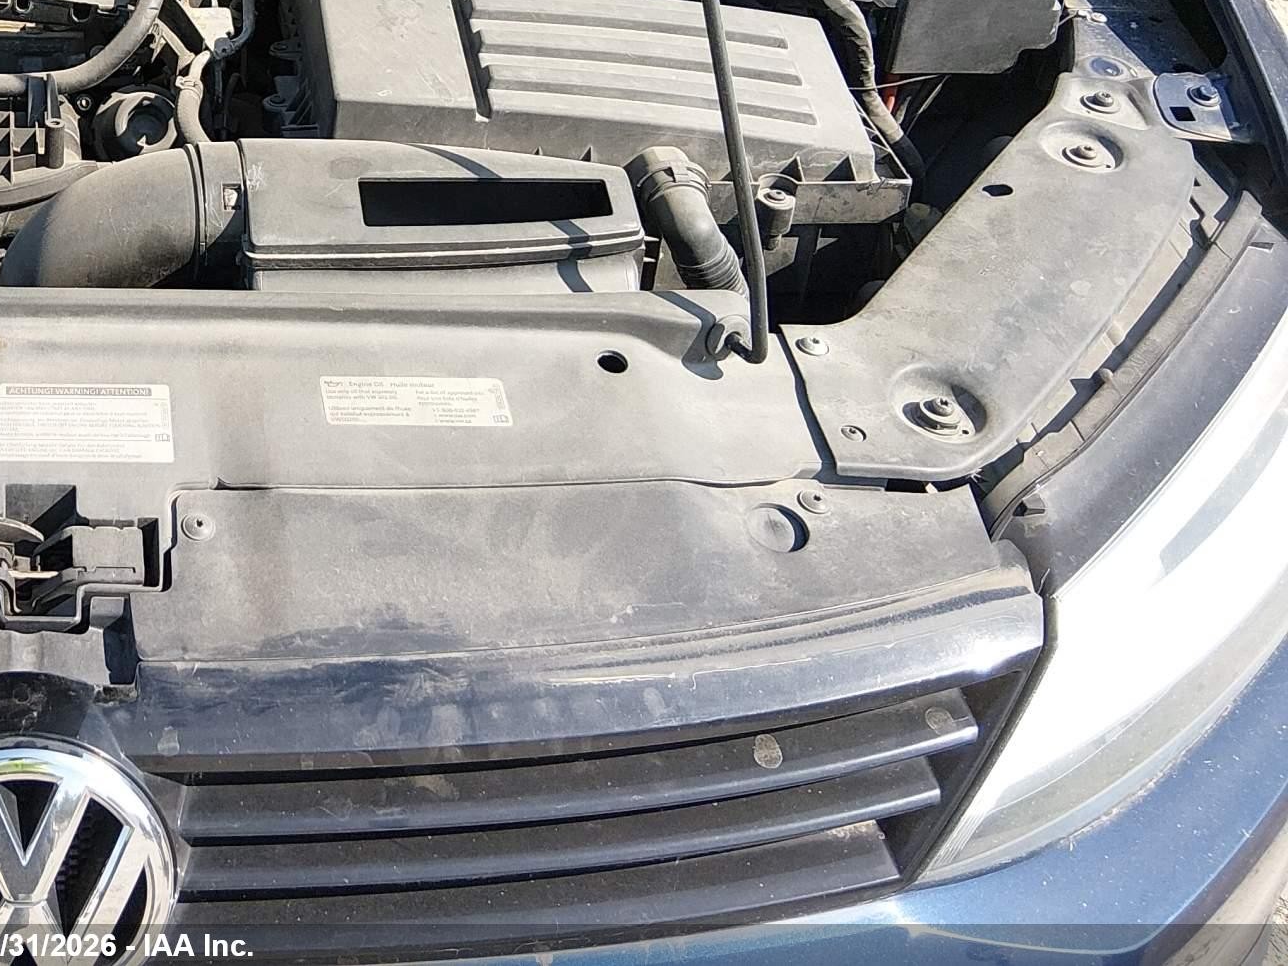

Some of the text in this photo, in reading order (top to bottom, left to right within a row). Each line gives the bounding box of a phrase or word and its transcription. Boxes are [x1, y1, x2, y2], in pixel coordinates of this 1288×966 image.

[8, 386, 150, 396] ACHTUNG! WARNING! ATTENTION!
